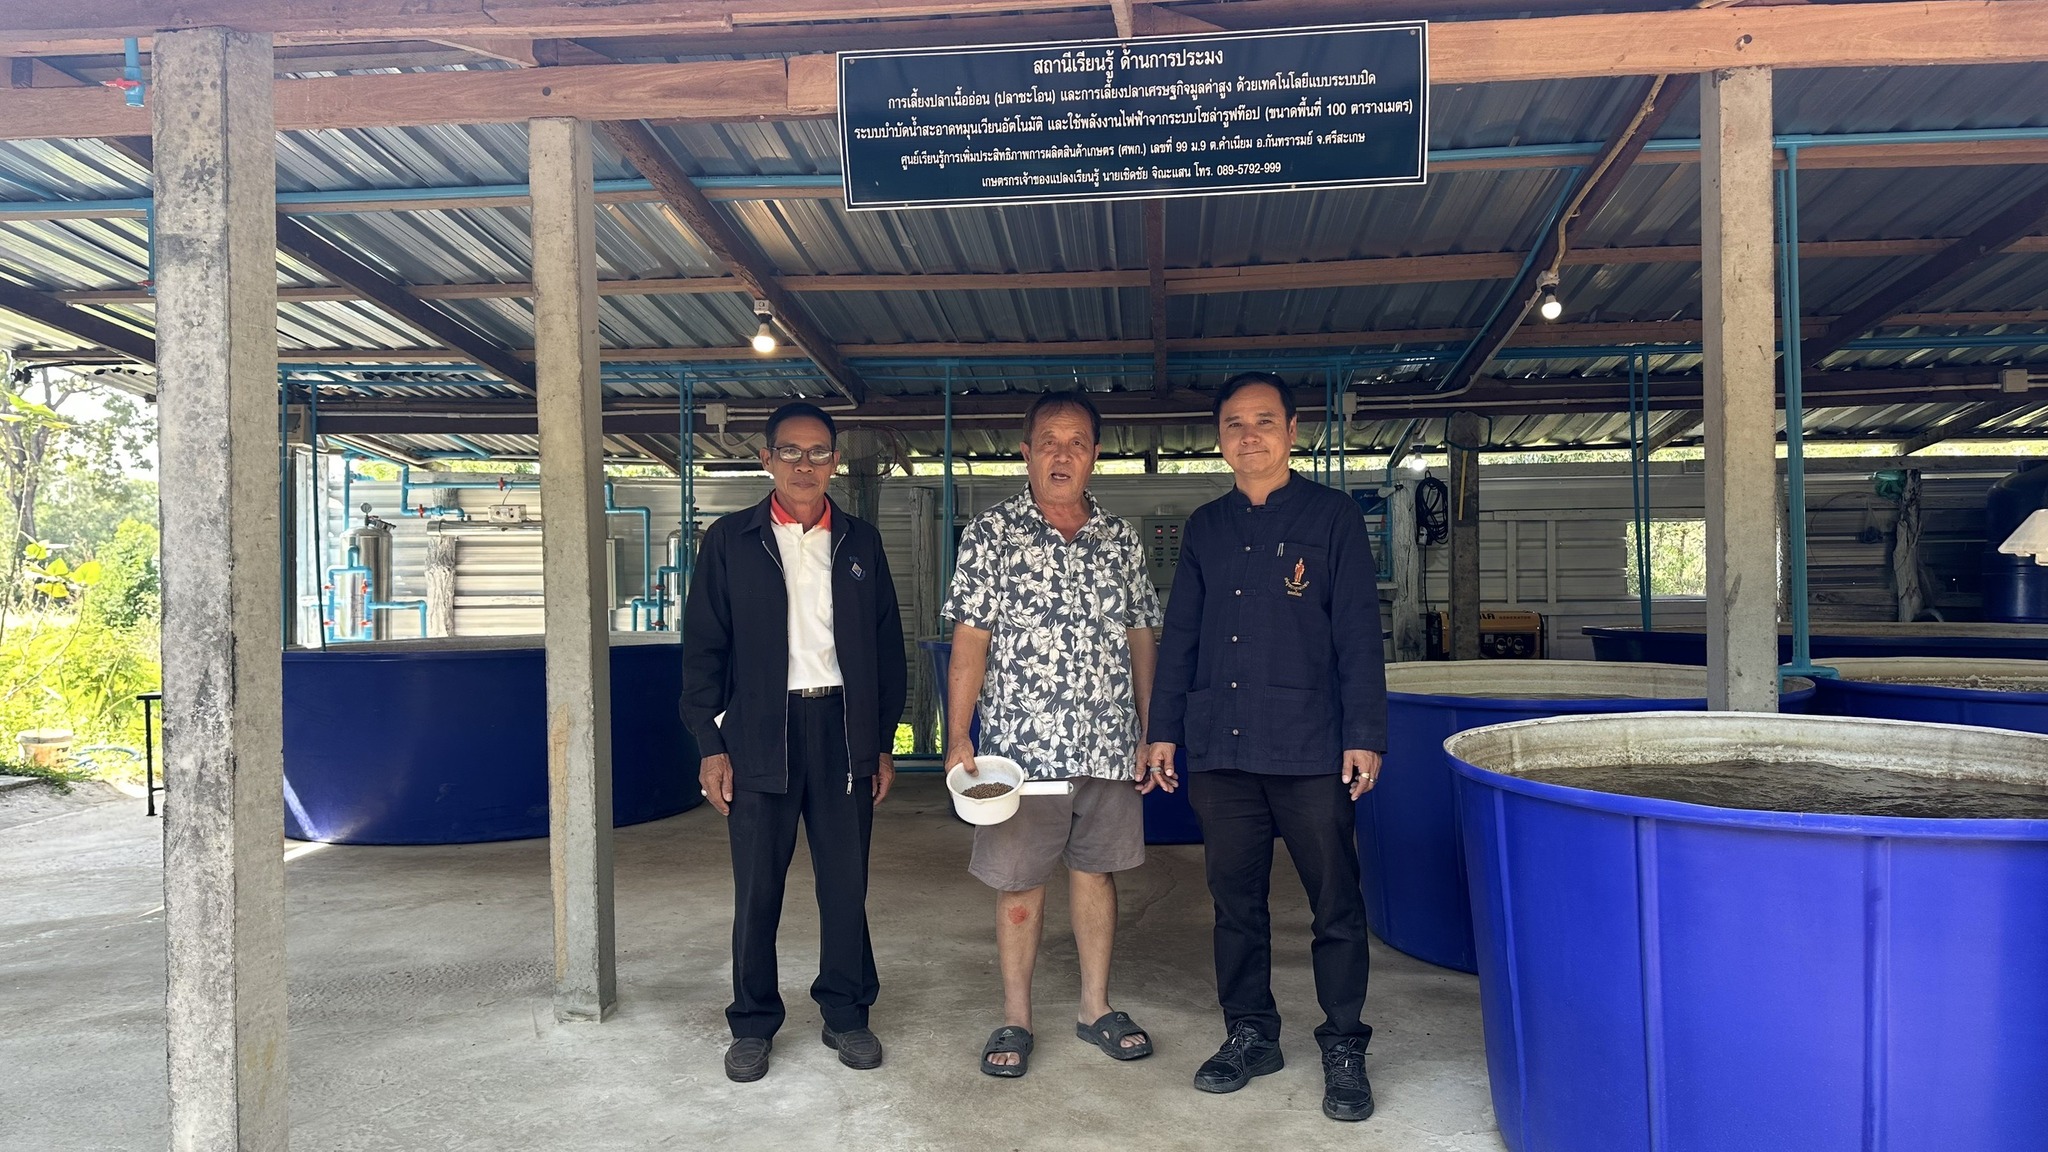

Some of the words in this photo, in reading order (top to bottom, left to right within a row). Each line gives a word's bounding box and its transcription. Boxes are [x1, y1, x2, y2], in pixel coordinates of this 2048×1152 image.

[1033, 49, 1115, 79] สถานีเรียนรู้
[1120, 48, 1224, 70] ด้านการประมง
[888, 86, 990, 109] การเลี้ยงปลาเนื้ออ่อน
[994, 85, 1056, 108] (ปลาชะโอน)
[1060, 78, 1232, 102] และการเลี้ยงปลาเศรษฐกิจมูลค่าสูง
[1236, 69, 1376, 92] ด้วยเทคโนโลยีแบบระบบปิด
[853, 115, 1043, 141] ระบบบำบัดน้ำสะอาดหมุนเวียนอัตโนมัติ
[1047, 104, 1261, 130] และใช้พลังงานไฟฟ้าจากระบบโซล่ารูฟท๊อป
[1265, 97, 1322, 122] (ขนาดพื้นที่
[1326, 102, 1347, 116] 100
[1350, 98, 1413, 116] ตารางเมตร)
[900, 145, 1115, 170] ศูนย์เรียนรู้การเพิ่มประสิทธิภาพการผลิตสินค้าเกษตร
[1118, 143, 1147, 157] (ศพก.)
[1150, 139, 1173, 154] เลขที่
[1175, 142, 1188, 152] 99
[1191, 141, 1207, 152] ม.9
[1209, 136, 1253, 151] ต.คำเนียม
[1256, 131, 1313, 148] อ.กันทรารมย์
[1316, 131, 1366, 145] จ.ศรีสะเกษ
[981, 168, 1100, 188] เกษตรกรเจ้าของแปลงเรียนรู้
[1102, 165, 1149, 182] นายเชิดชัย
[1193, 161, 1213, 177] โทร.
[1217, 161, 1282, 176] 089-5792-999
